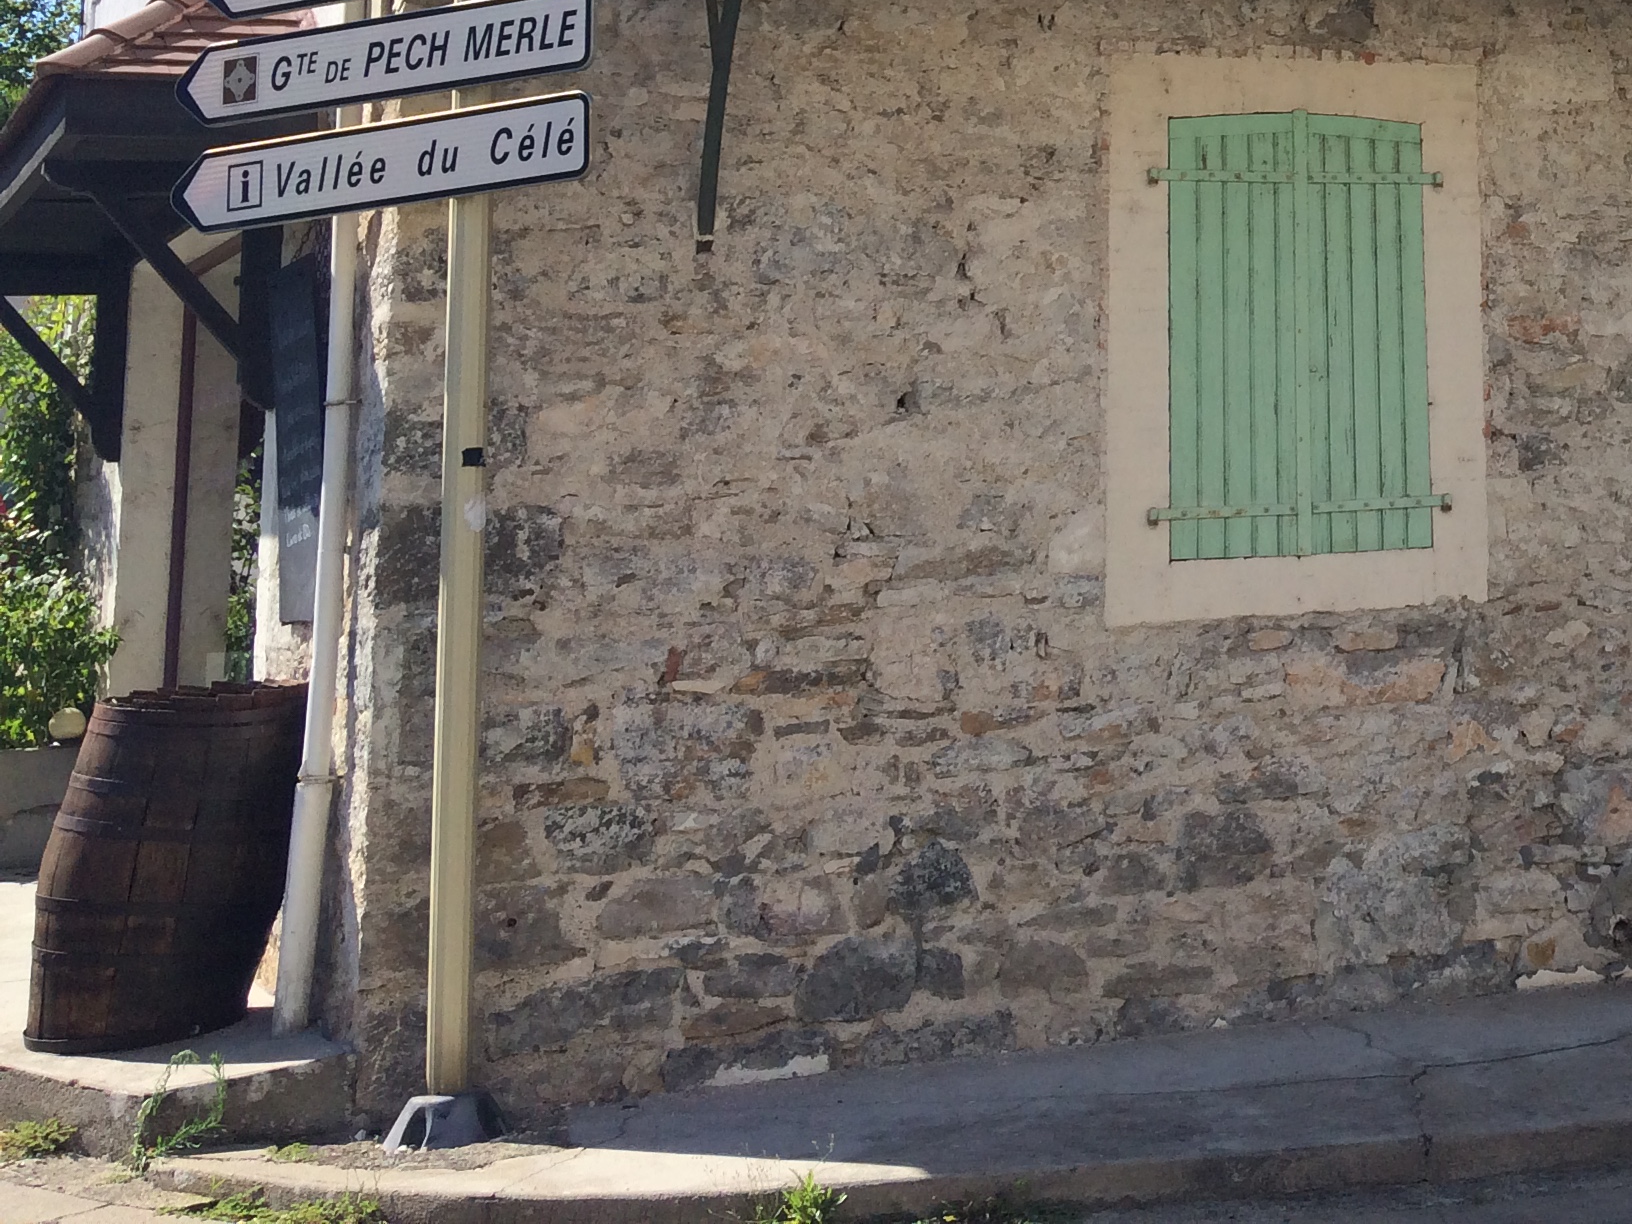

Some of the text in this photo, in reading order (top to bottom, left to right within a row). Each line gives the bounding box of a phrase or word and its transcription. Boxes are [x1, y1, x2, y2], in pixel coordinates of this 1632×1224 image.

[325, 59, 352, 84] DE
[363, 29, 450, 78] PECH
[463, 9, 579, 64] MERLE
[275, 152, 387, 198] Vallée
[417, 139, 460, 178] du
[489, 117, 576, 166] Célé
